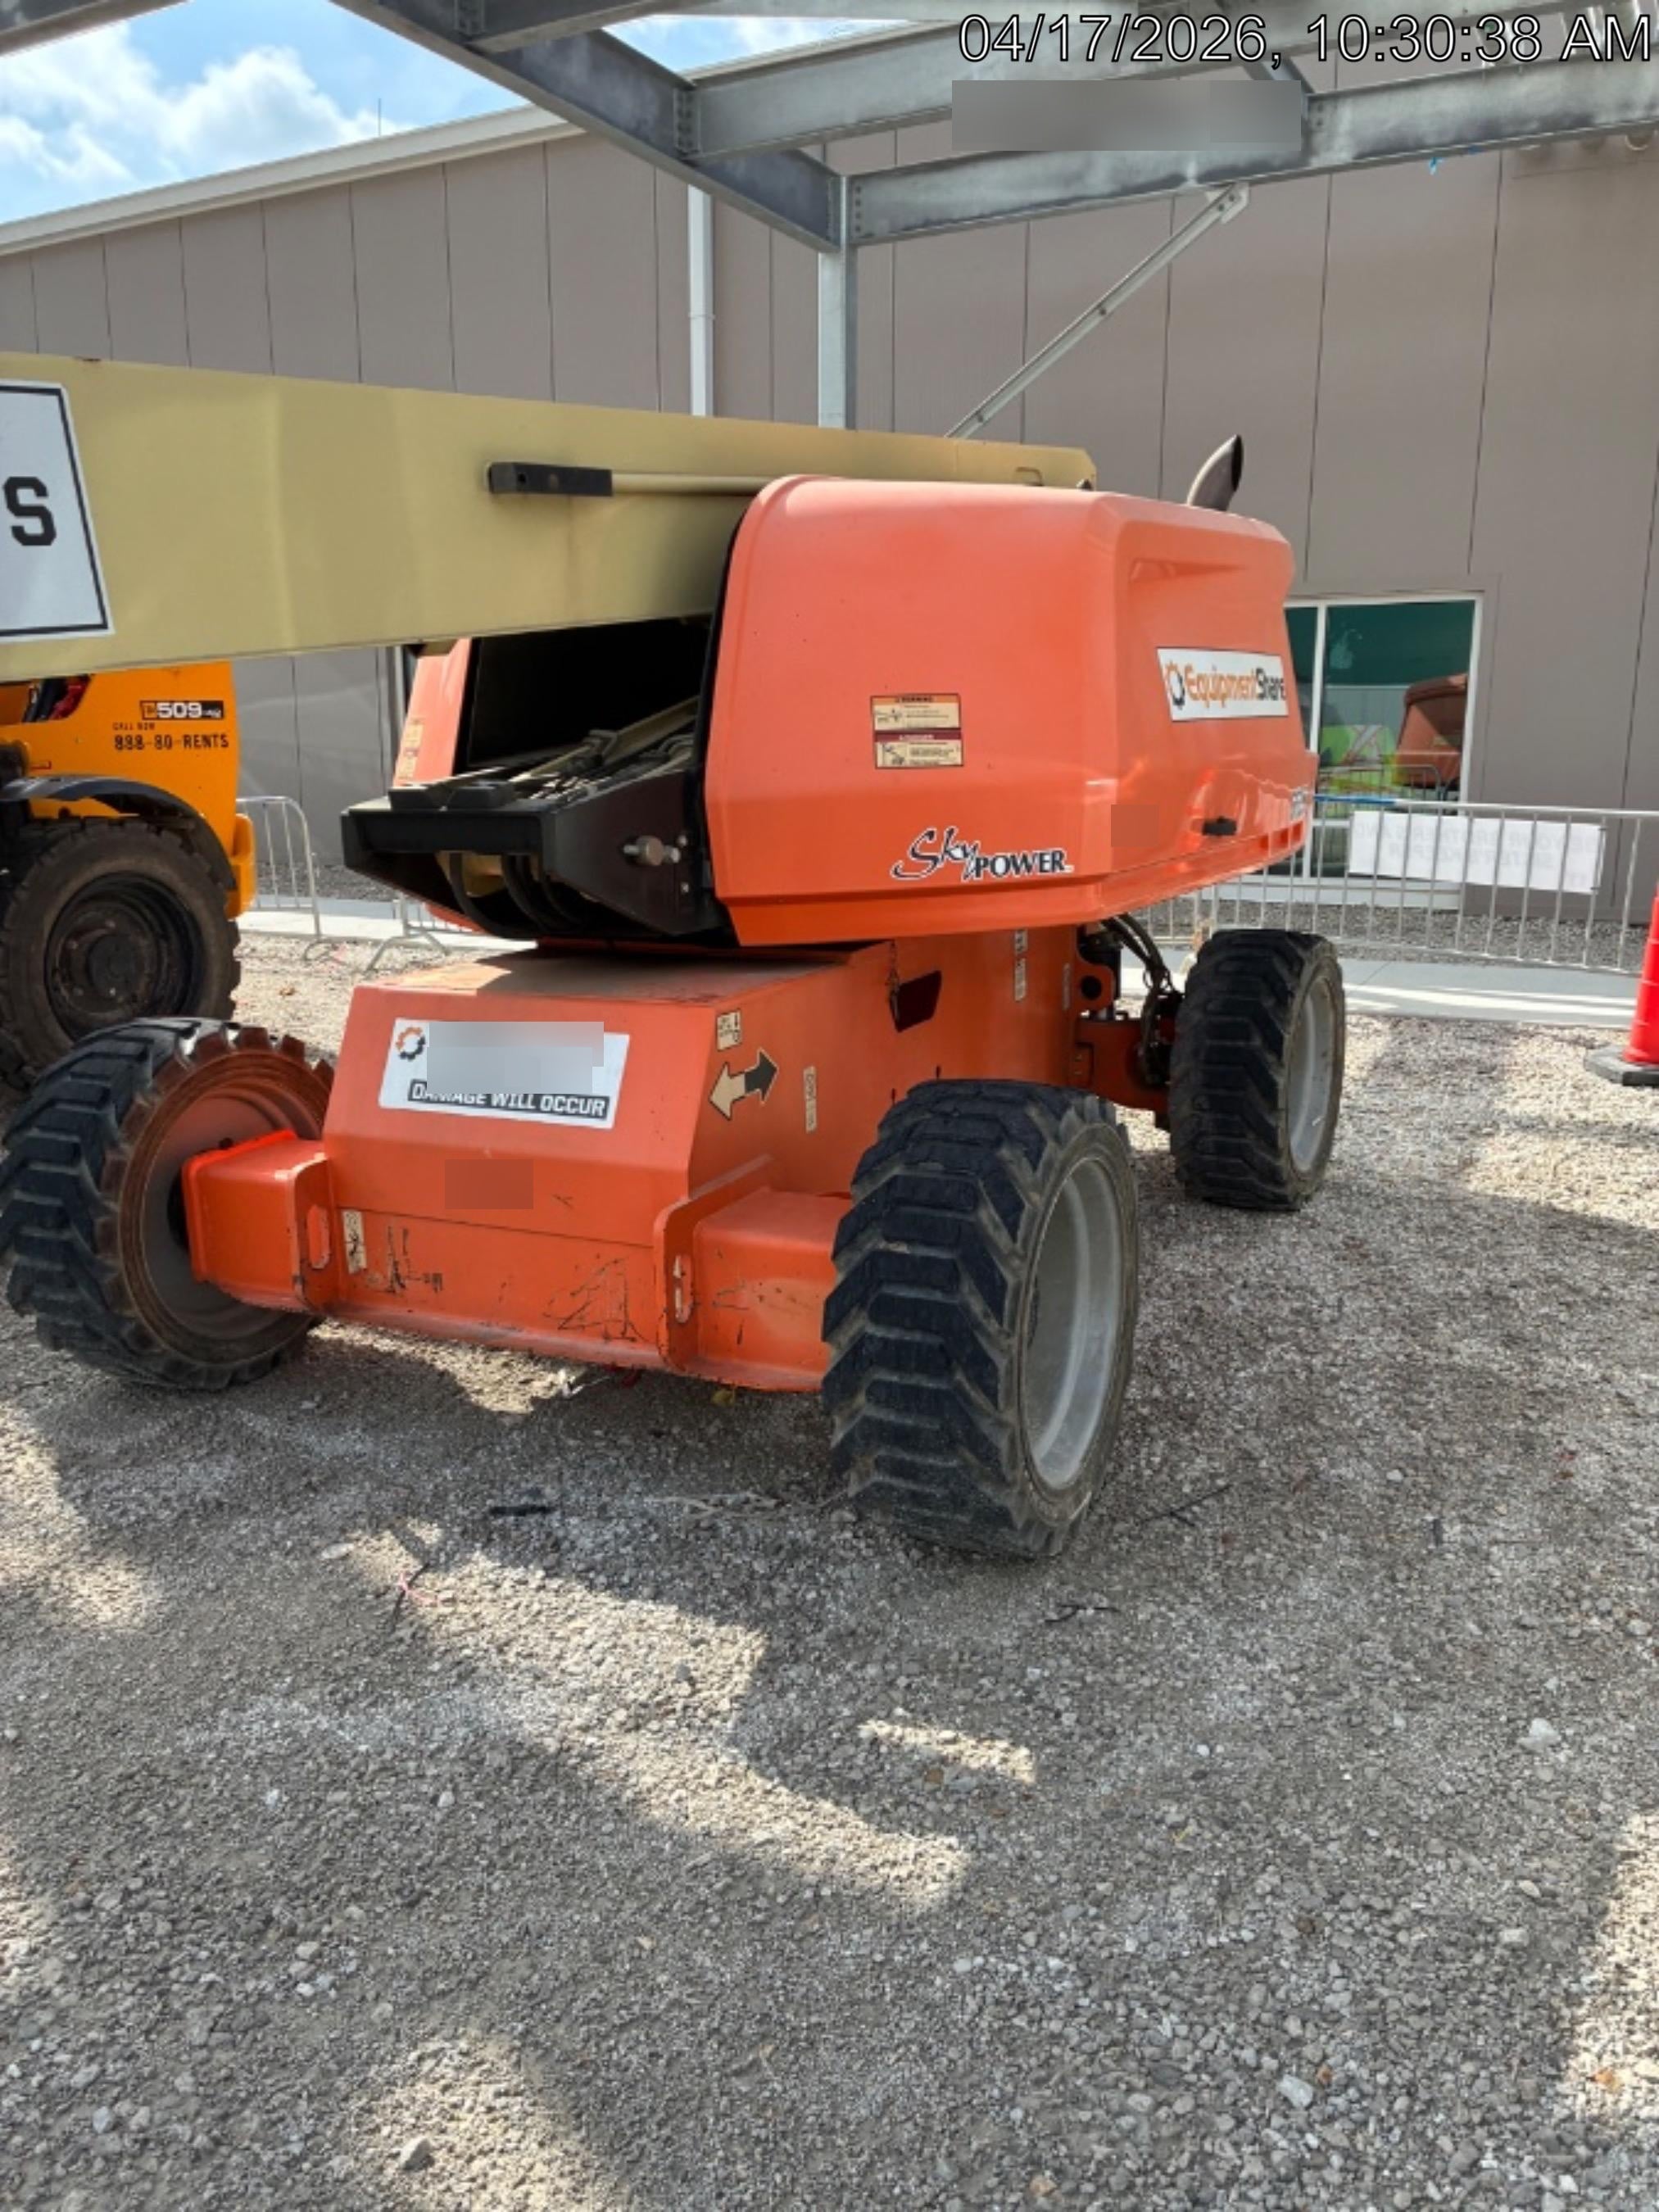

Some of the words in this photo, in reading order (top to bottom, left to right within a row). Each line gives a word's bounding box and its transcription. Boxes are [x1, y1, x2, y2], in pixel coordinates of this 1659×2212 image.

[891, 827, 982, 882] Sky
[973, 848, 1067, 879] POWER
[540, 1095, 605, 1117] OCCUR
